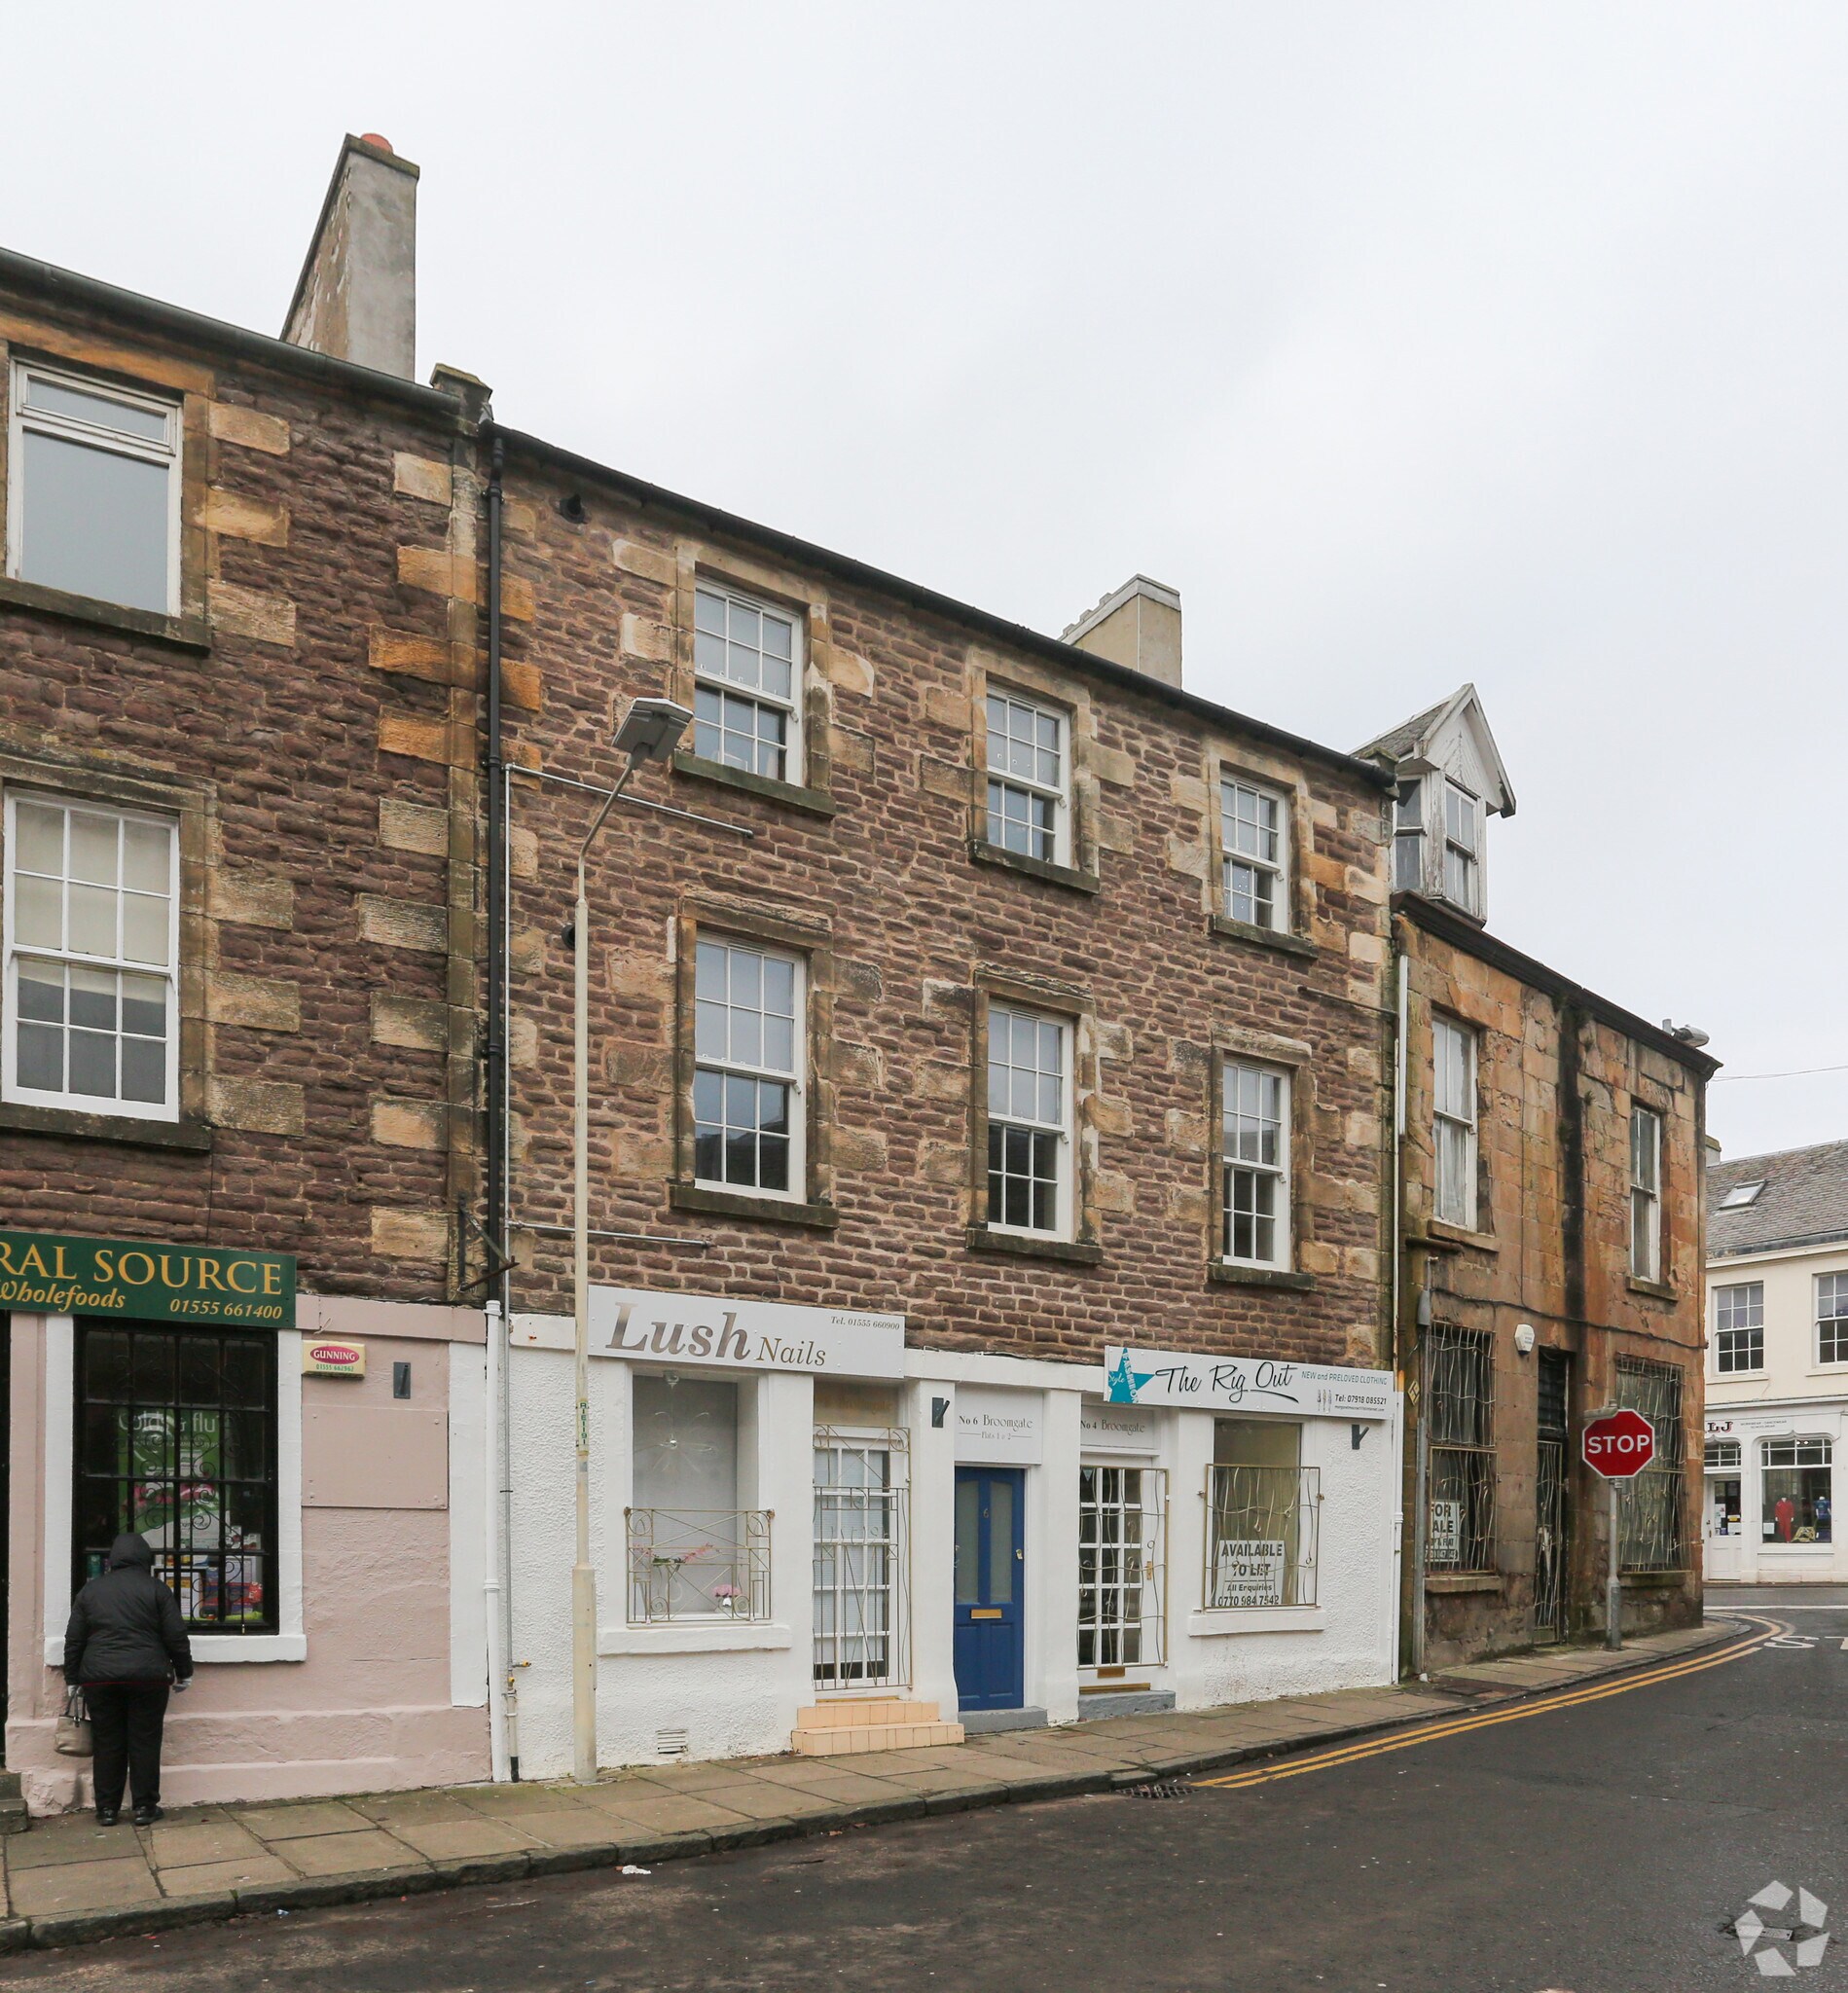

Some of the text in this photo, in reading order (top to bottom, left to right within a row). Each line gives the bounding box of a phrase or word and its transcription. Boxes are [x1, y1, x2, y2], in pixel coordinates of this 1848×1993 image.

[93, 1250, 282, 1295] SOURCE
[169, 1298, 282, 1320] 01555 661400
[848, 1318, 871, 1327] 01555
[872, 1322, 900, 1330] 660900
[605, 1301, 826, 1366] Lush Nails
[313, 1350, 356, 1361] GUNNING
[1155, 1361, 1298, 1403] The Rig Out
[1301, 1371, 1317, 1380] NEW
[1328, 1373, 1359, 1383] PRELOVED
[1359, 1375, 1388, 1386] CLOTHING
[972, 1417, 979, 1426] 6
[983, 1414, 1033, 1432] Broomgate
[1101, 1419, 1145, 1436] Broomgate
[1587, 1434, 1650, 1454] STOP
[983, 1508, 990, 1518] 6
[1221, 1543, 1283, 1557] AVAILABLE
[1250, 1563, 1271, 1576] LET
[1217, 1596, 1240, 1607] 0770
